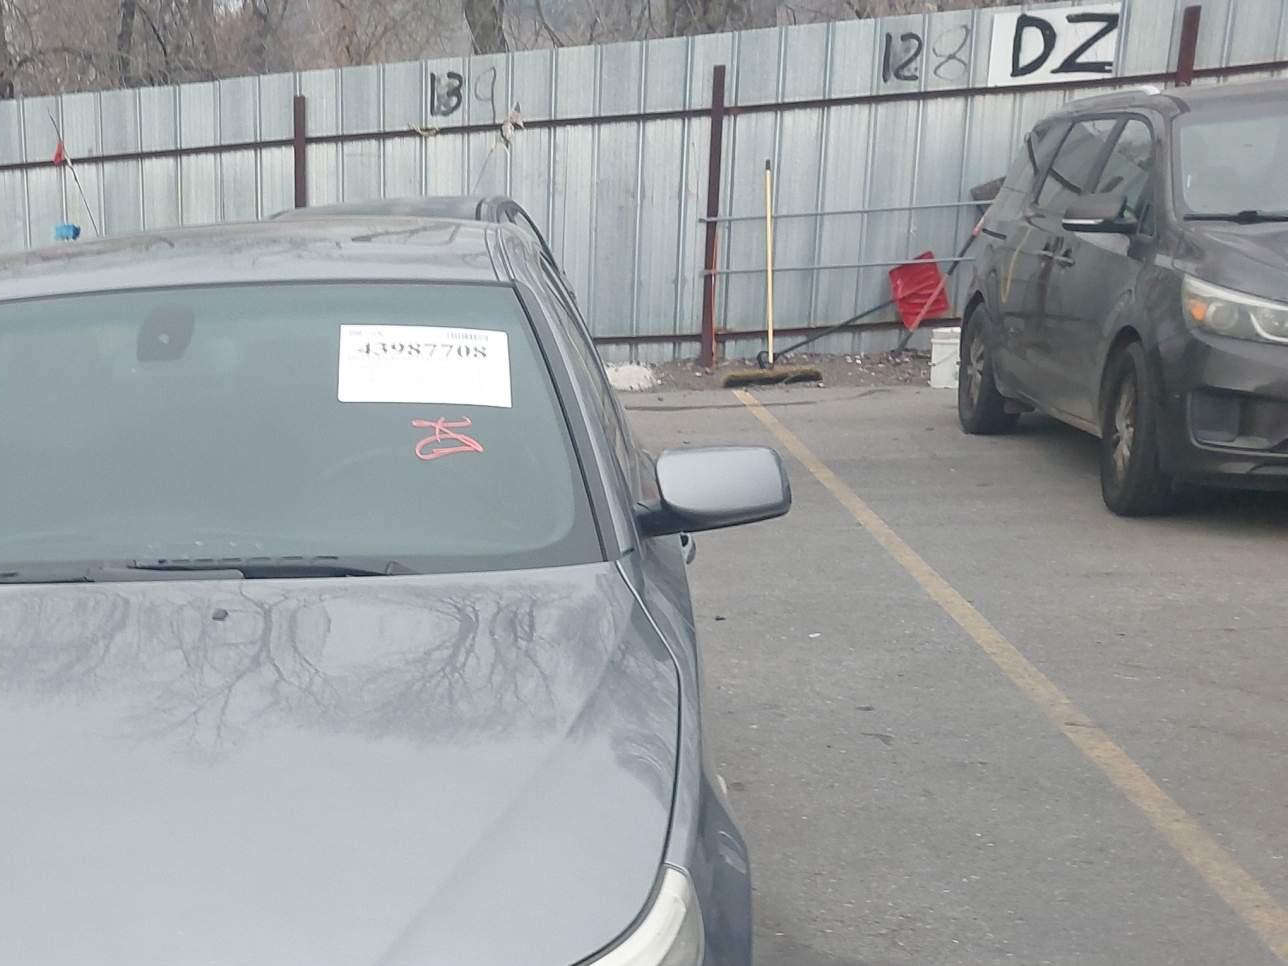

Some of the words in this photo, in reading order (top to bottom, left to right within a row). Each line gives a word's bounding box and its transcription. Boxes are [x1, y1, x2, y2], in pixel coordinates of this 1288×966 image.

[882, 32, 923, 83] 12
[1010, 13, 1120, 77] DZ
[430, 71, 463, 117] 13
[357, 341, 487, 358] 43987708
